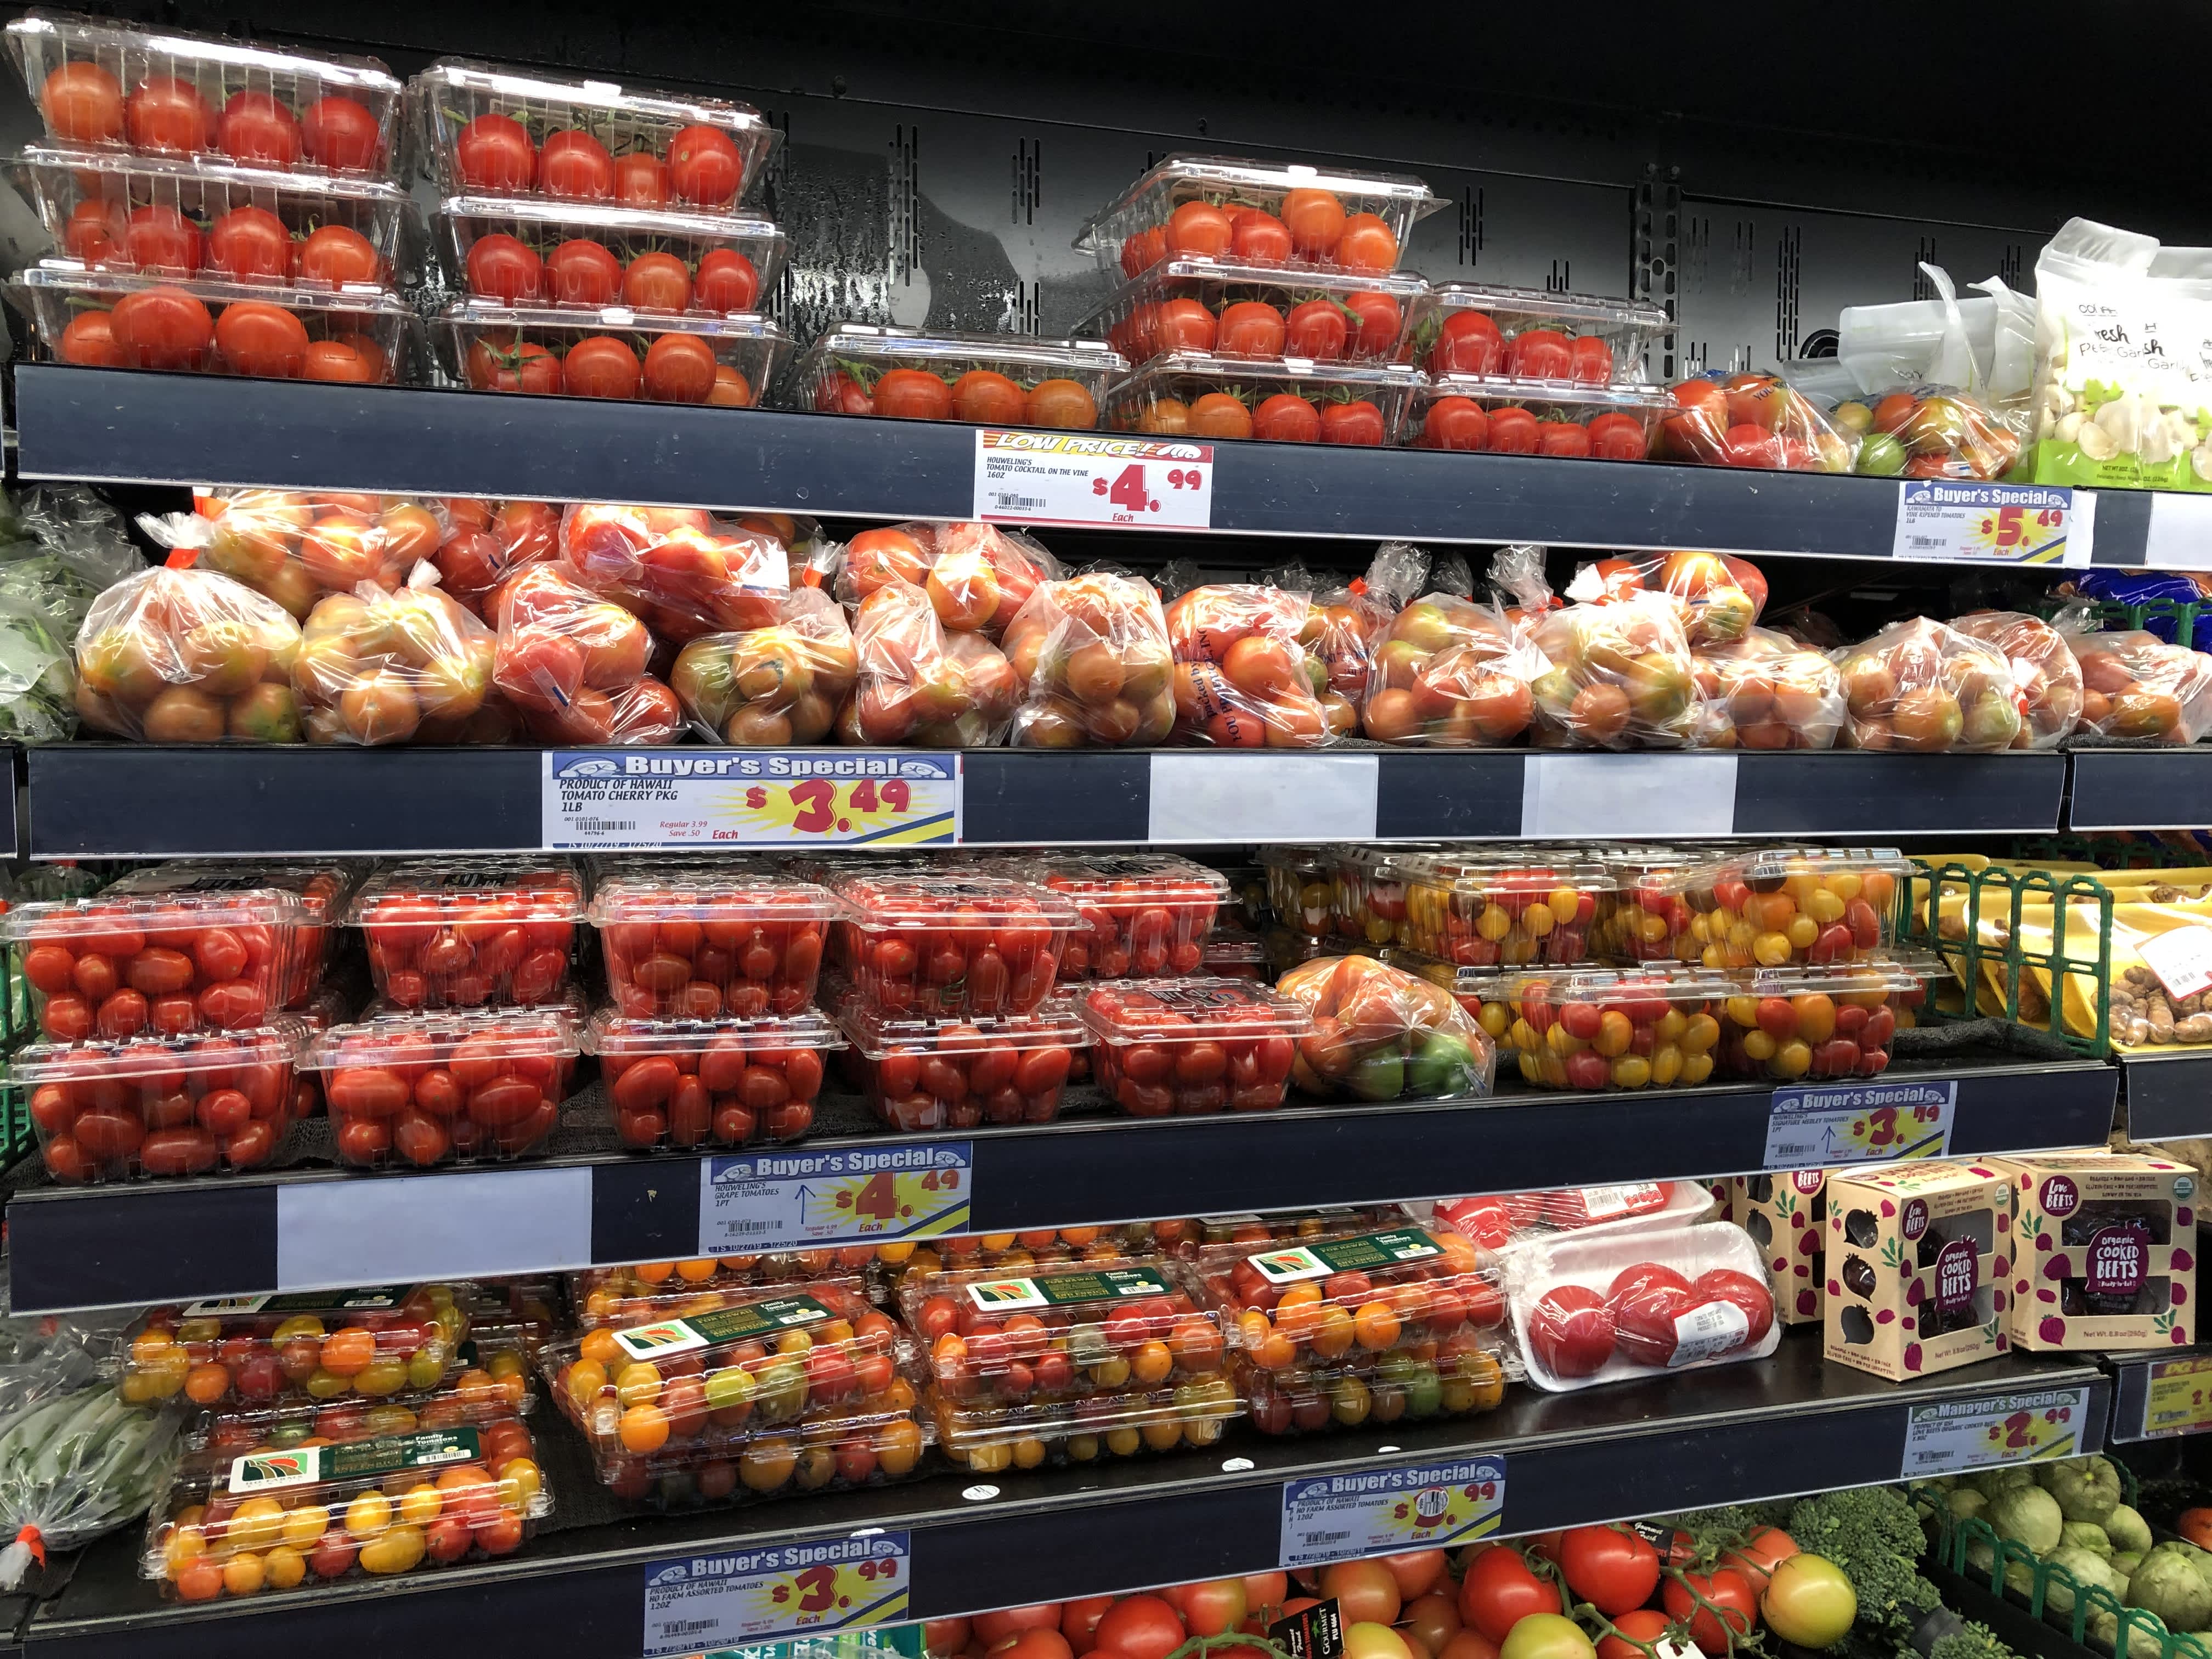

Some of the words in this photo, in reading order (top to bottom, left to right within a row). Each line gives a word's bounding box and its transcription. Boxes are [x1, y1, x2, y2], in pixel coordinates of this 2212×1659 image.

[995, 434, 1060, 450] LOW
[1062, 438, 1155, 456] PRICE!
[987, 456, 1032, 466] HOUWELING'S
[987, 464, 1013, 472] TOMATO
[1014, 466, 1046, 474] COCKTAIL
[1934, 487, 1989, 504] Buyer's
[1991, 488, 2047, 505] Special
[1112, 513, 1134, 522] Each
[624, 756, 764, 778] Buyer's
[769, 757, 901, 777] Special
[558, 779, 609, 789] PRODUCT
[611, 779, 628, 789] OF
[630, 779, 674, 789] HAWAII
[561, 791, 606, 801] TOMATO
[608, 791, 655, 801] CHERRY
[657, 791, 679, 802] PKG
[561, 802, 583, 812] 1LB
[659, 821, 689, 830] Regular
[668, 829, 686, 837] Save
[712, 830, 738, 840] Each
[1803, 1092, 1863, 1109] Buyer's
[1865, 1087, 1925, 1104] Special
[1865, 1148, 1883, 1156] Each
[757, 1154, 843, 1177] Buyer's
[848, 1148, 933, 1171] Special
[1798, 1172, 1819, 1187] BEETS
[715, 1182, 766, 1192] HOUWELING'S
[2049, 1180, 2068, 1194] Love
[714, 1189, 746, 1199] GRAPE
[747, 1188, 780, 1198] TOMATOES
[715, 1199, 730, 1207] 1PT
[2046, 1194, 2073, 1209] BEETS
[1908, 1205, 1922, 1220] Love
[858, 1223, 883, 1233] Each
[1906, 1216, 1925, 1234] BEETS
[1379, 1235, 1411, 1244] Tomatoes
[2102, 1234, 2135, 1247] organic
[1945, 1250, 1968, 1262] organic
[2096, 1245, 2140, 1261] COOKED
[1942, 1260, 1972, 1278] COOKED
[2096, 1260, 2138, 1279] BEETS
[1942, 1274, 1971, 1297] BEETS
[760, 1300, 784, 1308] Family
[764, 1301, 800, 1311] Tomatoes
[1938, 1398, 2006, 1417] Manager's
[2008, 1392, 2057, 1409] Special
[416, 1435, 458, 1444] Tomatoes
[1332, 1472, 1404, 1493] Buyer's
[1407, 1464, 1476, 1486] Special
[1297, 1498, 1326, 1506] PRODUCT
[1326, 1502, 1356, 1511] ASSORTED
[1358, 1499, 1389, 1508] TOMATOES
[1411, 1531, 1431, 1540] Each
[692, 1551, 780, 1577] Buyer's
[785, 1539, 872, 1565] Special
[650, 1584, 686, 1595] PRODUCT
[698, 1579, 727, 1588] HAWAII
[662, 1592, 684, 1601] FARM
[685, 1588, 724, 1598] ASSORTED
[725, 1581, 764, 1592] TOMATOES
[795, 1615, 821, 1626] Each
[1319, 1607, 1330, 1655] GOURMET
